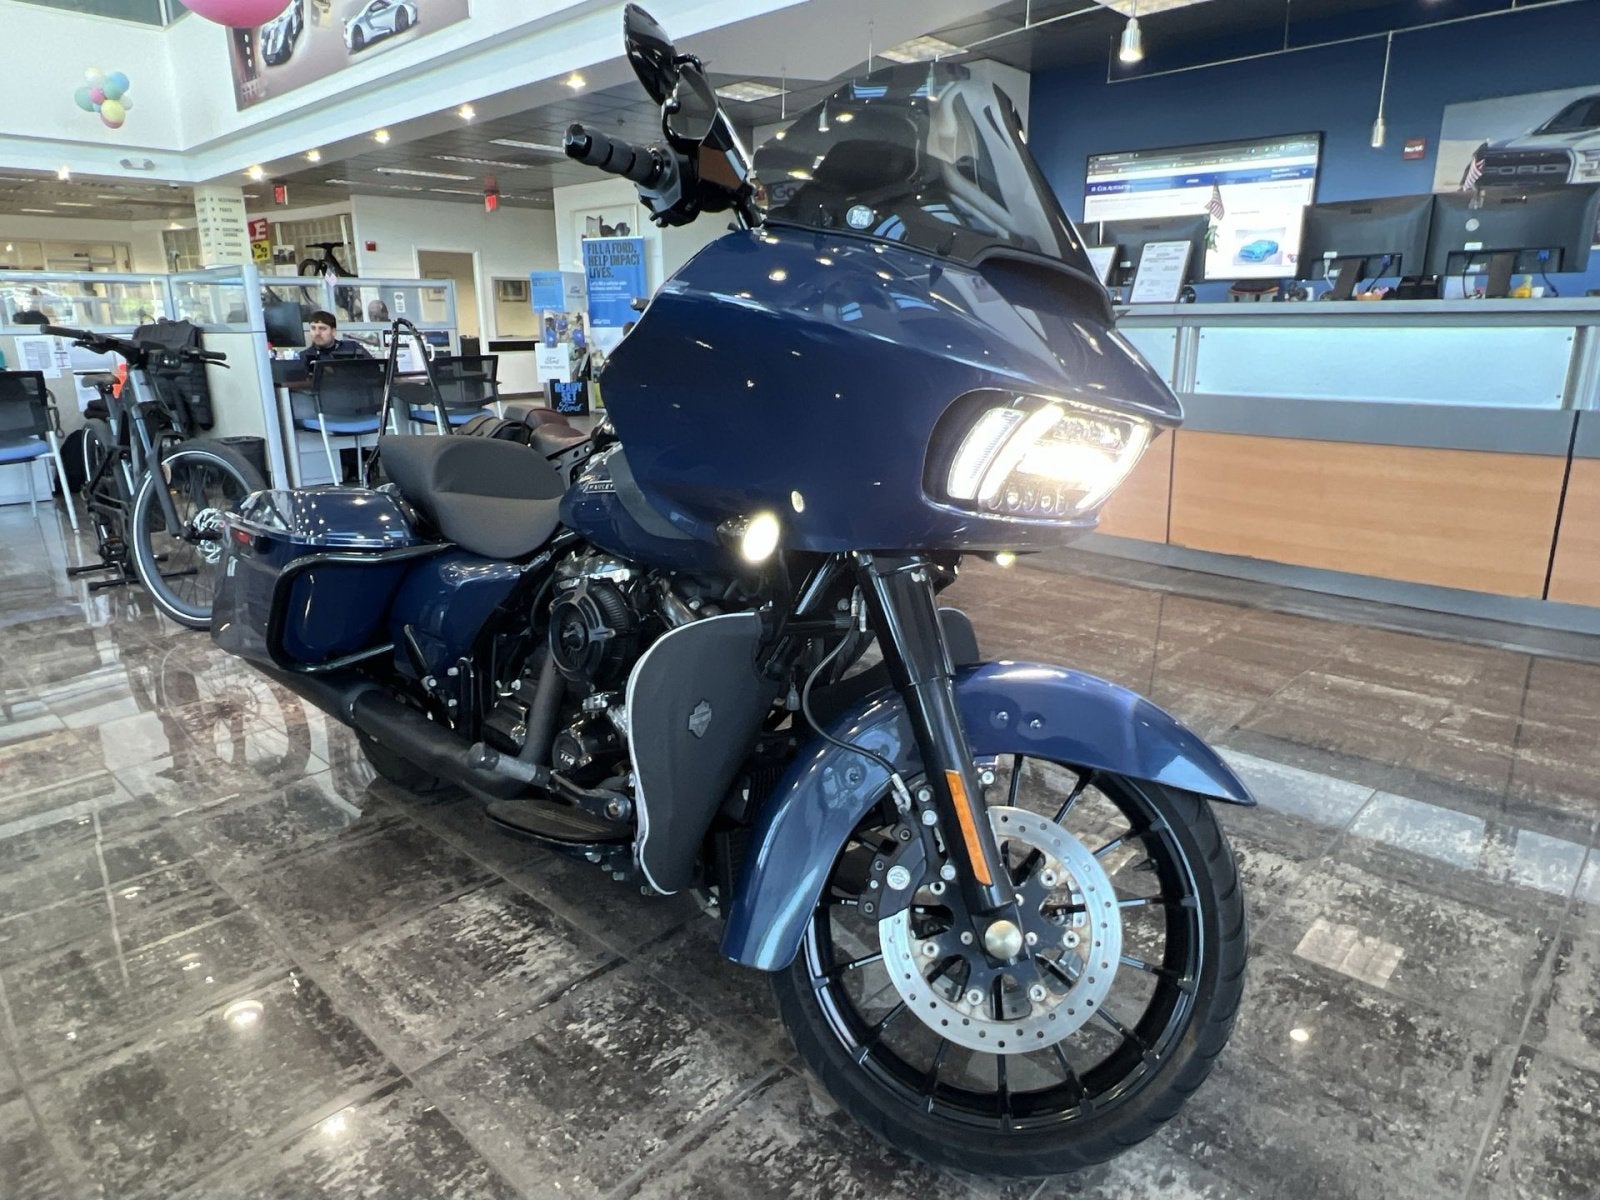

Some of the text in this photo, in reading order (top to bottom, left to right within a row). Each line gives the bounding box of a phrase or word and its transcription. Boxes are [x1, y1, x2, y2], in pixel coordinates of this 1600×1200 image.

[587, 242, 637, 255] FILL A FORD.
[588, 254, 640, 267] HELP IMPACT
[589, 267, 614, 279] LIVES.
[561, 391, 577, 403] SET
[556, 402, 583, 413] Ford
